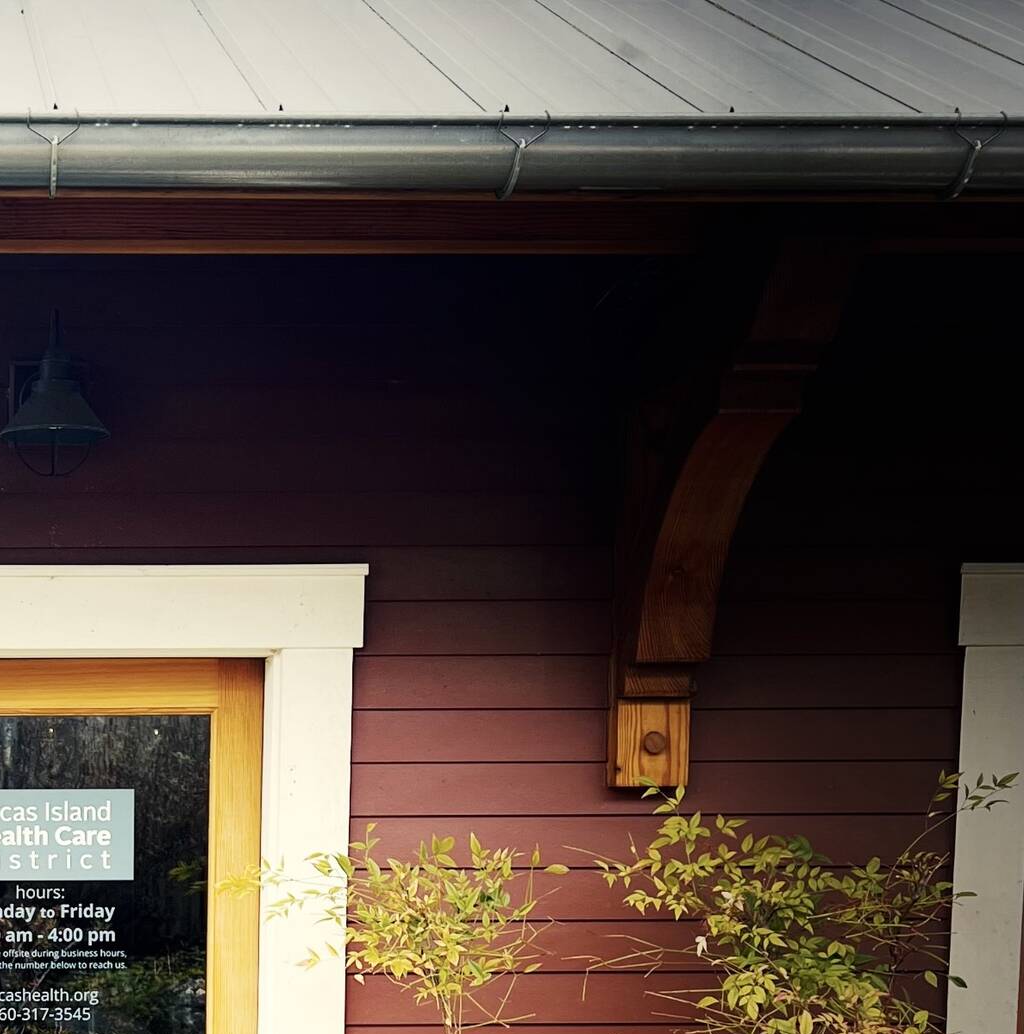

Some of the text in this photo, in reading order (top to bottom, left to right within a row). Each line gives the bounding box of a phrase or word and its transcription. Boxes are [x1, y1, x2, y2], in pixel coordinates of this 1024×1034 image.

[45, 801, 111, 821] Island
[55, 827, 111, 846] Care
[16, 885, 65, 899] hours:
[40, 908, 54, 918] to
[61, 904, 115, 921] Friday
[5, 932, 32, 942] am
[48, 928, 83, 942] 4:00
[88, 931, 115, 945] pm
[32, 950, 59, 960] during
